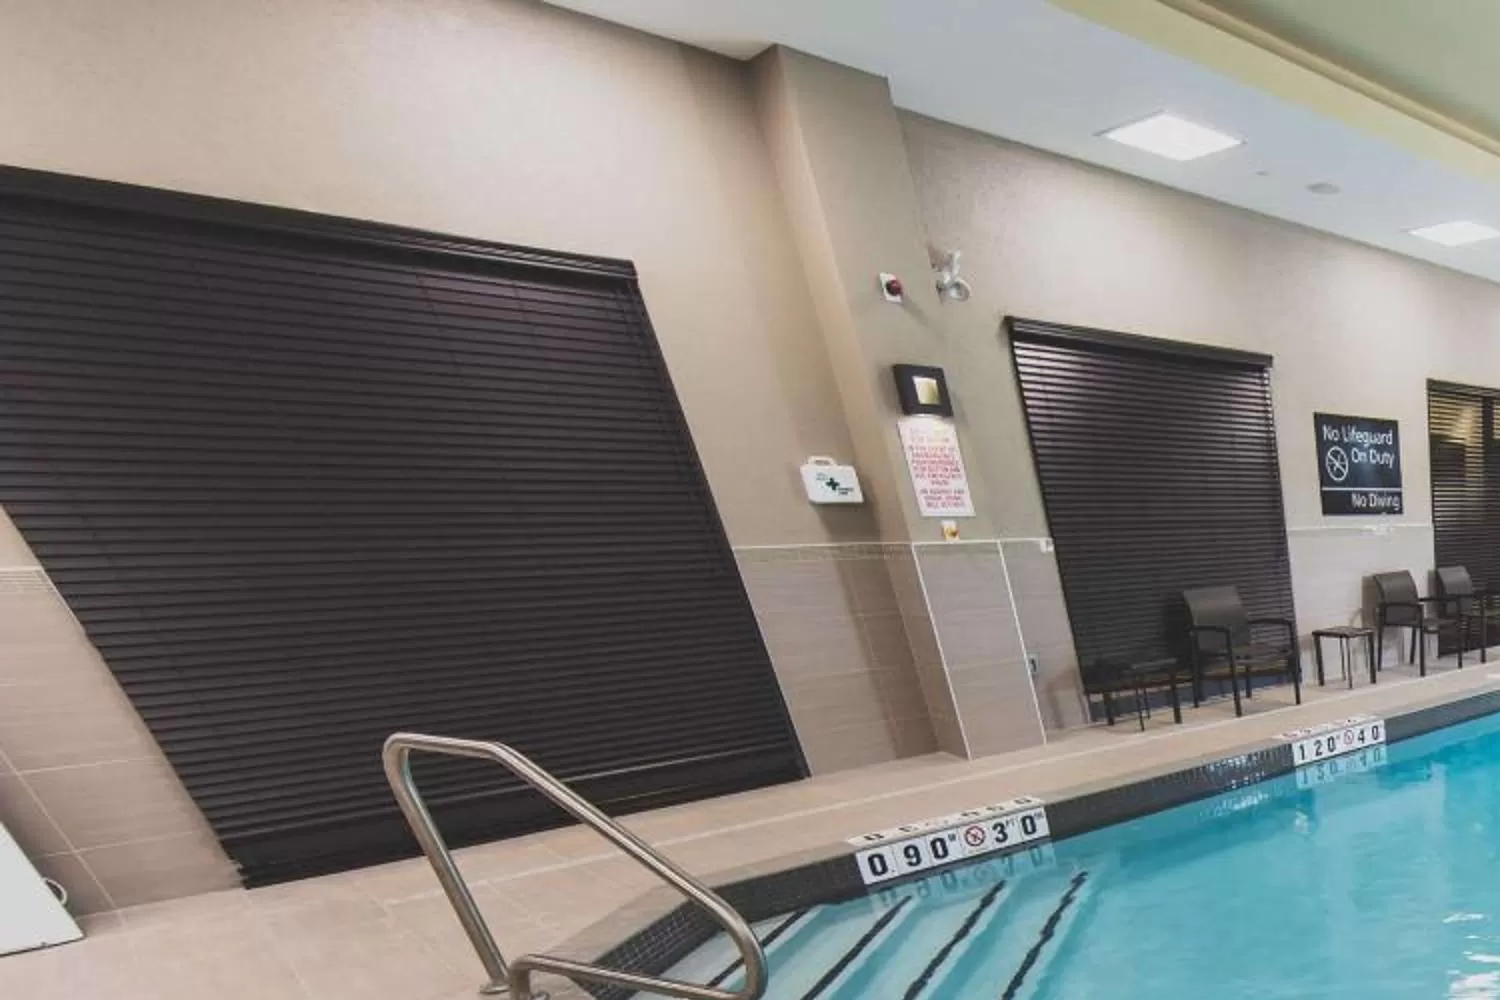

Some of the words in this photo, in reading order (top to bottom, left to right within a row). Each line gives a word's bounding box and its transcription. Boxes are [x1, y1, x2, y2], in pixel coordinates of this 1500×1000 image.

[1322, 424, 1340, 441] No
[1342, 424, 1393, 447] Lifeguard
[1351, 448, 1367, 463] On
[1370, 448, 1395, 468] Duty
[1351, 493, 1366, 508] No
[1368, 493, 1400, 511] Diving
